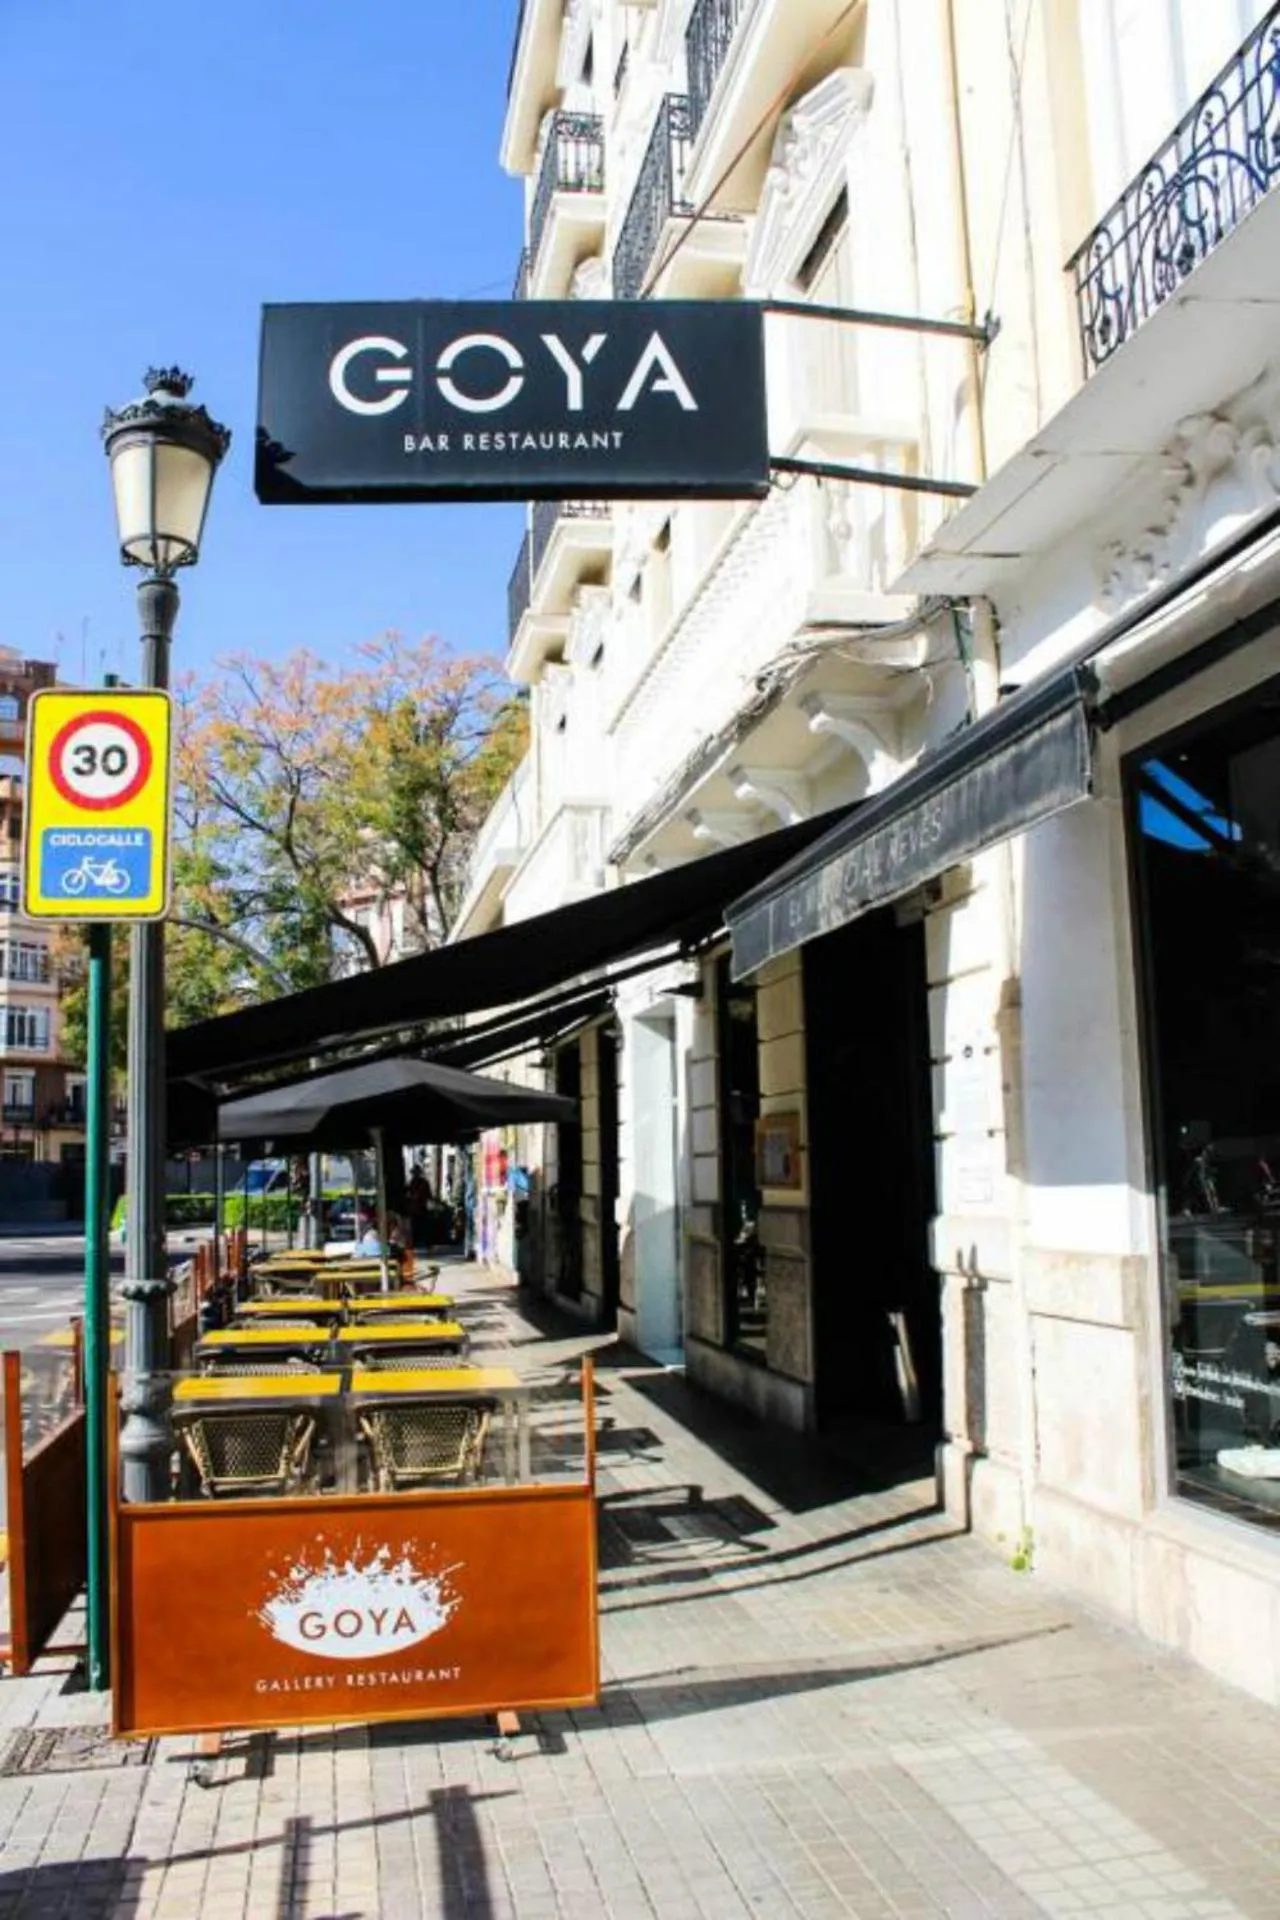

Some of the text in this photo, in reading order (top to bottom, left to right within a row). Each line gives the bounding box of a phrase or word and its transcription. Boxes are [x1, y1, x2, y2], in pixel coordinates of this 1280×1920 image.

[329, 331, 698, 416] GOYA
[404, 431, 624, 453] BAR RESTAURANT
[72, 744, 128, 777] 30
[49, 832, 146, 847] CICLOCALLE
[299, 1607, 417, 1641] GOYA
[255, 1666, 462, 1694] GALLERY RESTAURANT
